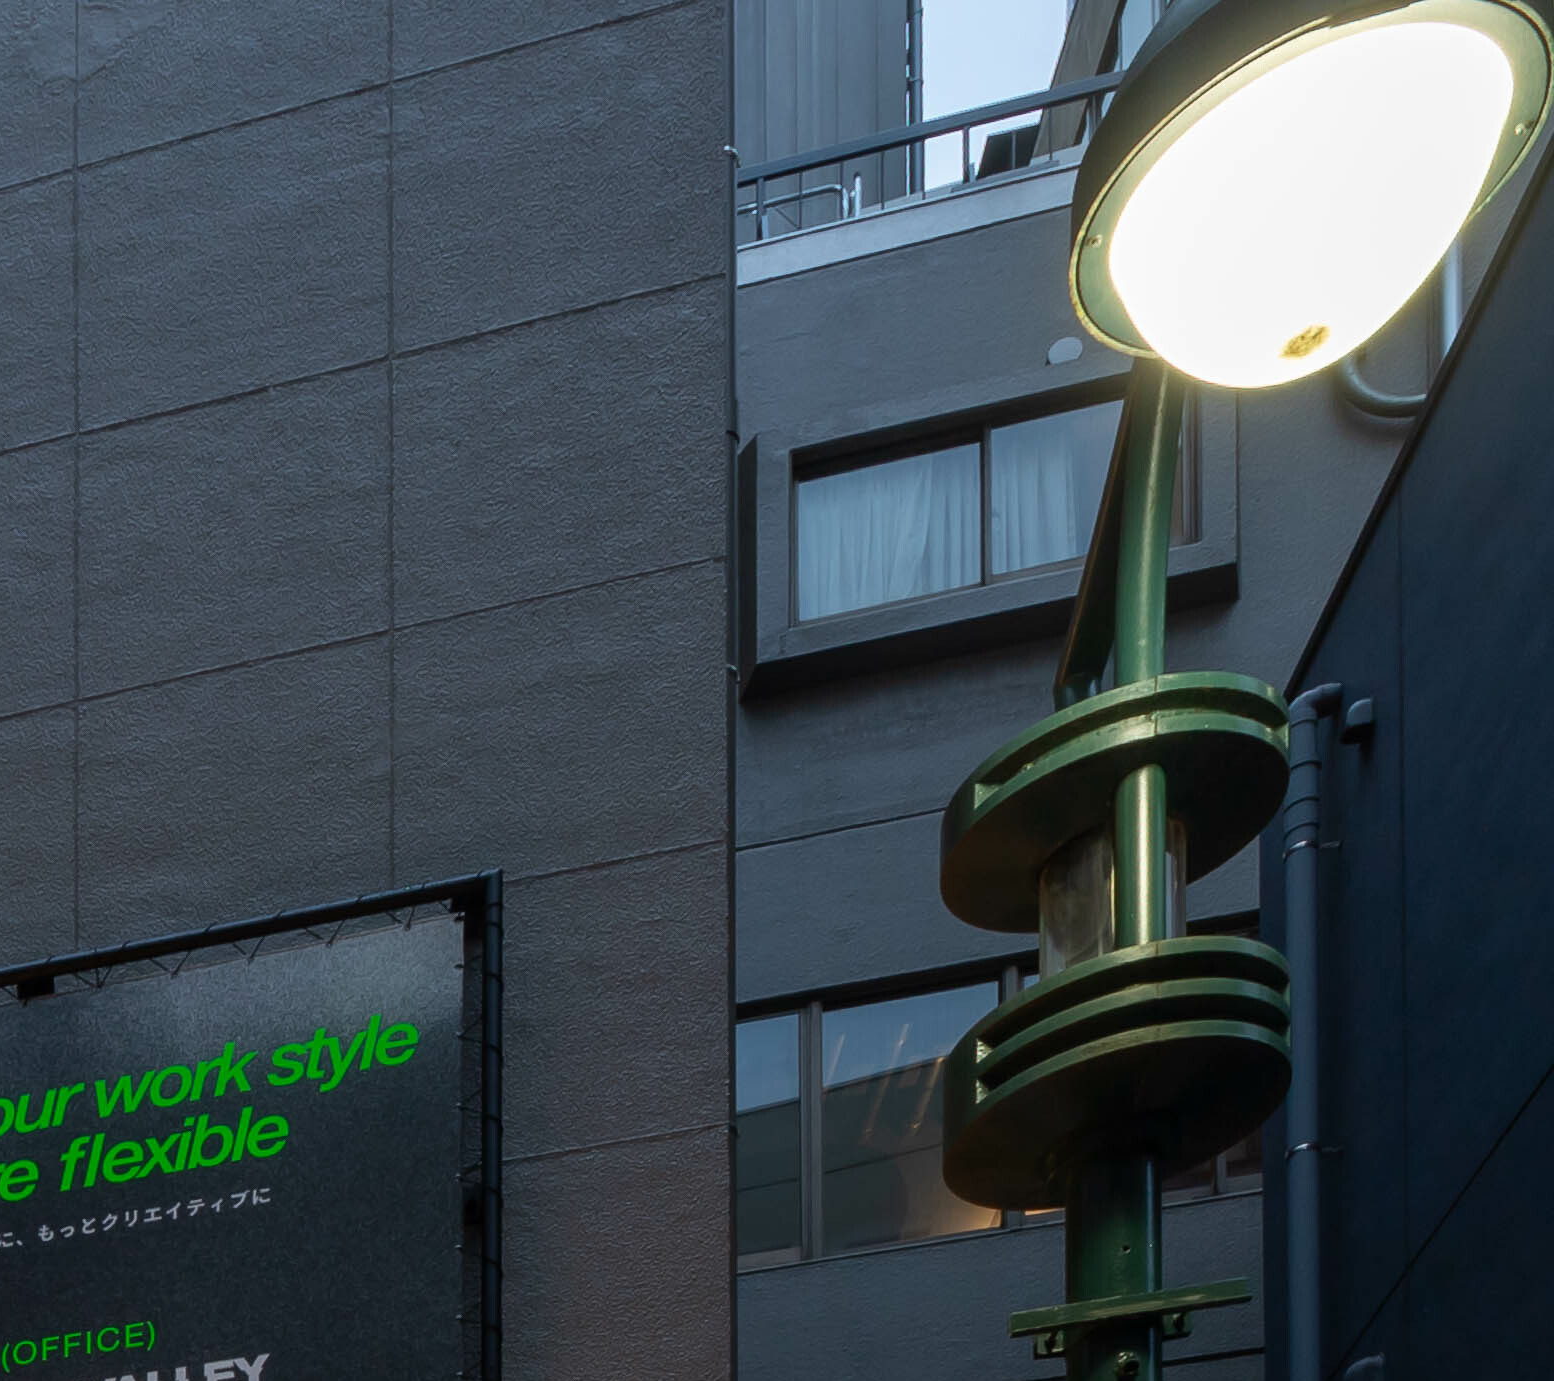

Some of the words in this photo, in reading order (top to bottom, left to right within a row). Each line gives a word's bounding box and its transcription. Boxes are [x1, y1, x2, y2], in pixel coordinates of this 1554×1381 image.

[94, 1039, 255, 1116] work
[266, 1011, 420, 1092] style
[58, 1105, 290, 1194] flexible
[1, 1320, 156, 1374] (OFFICE)
